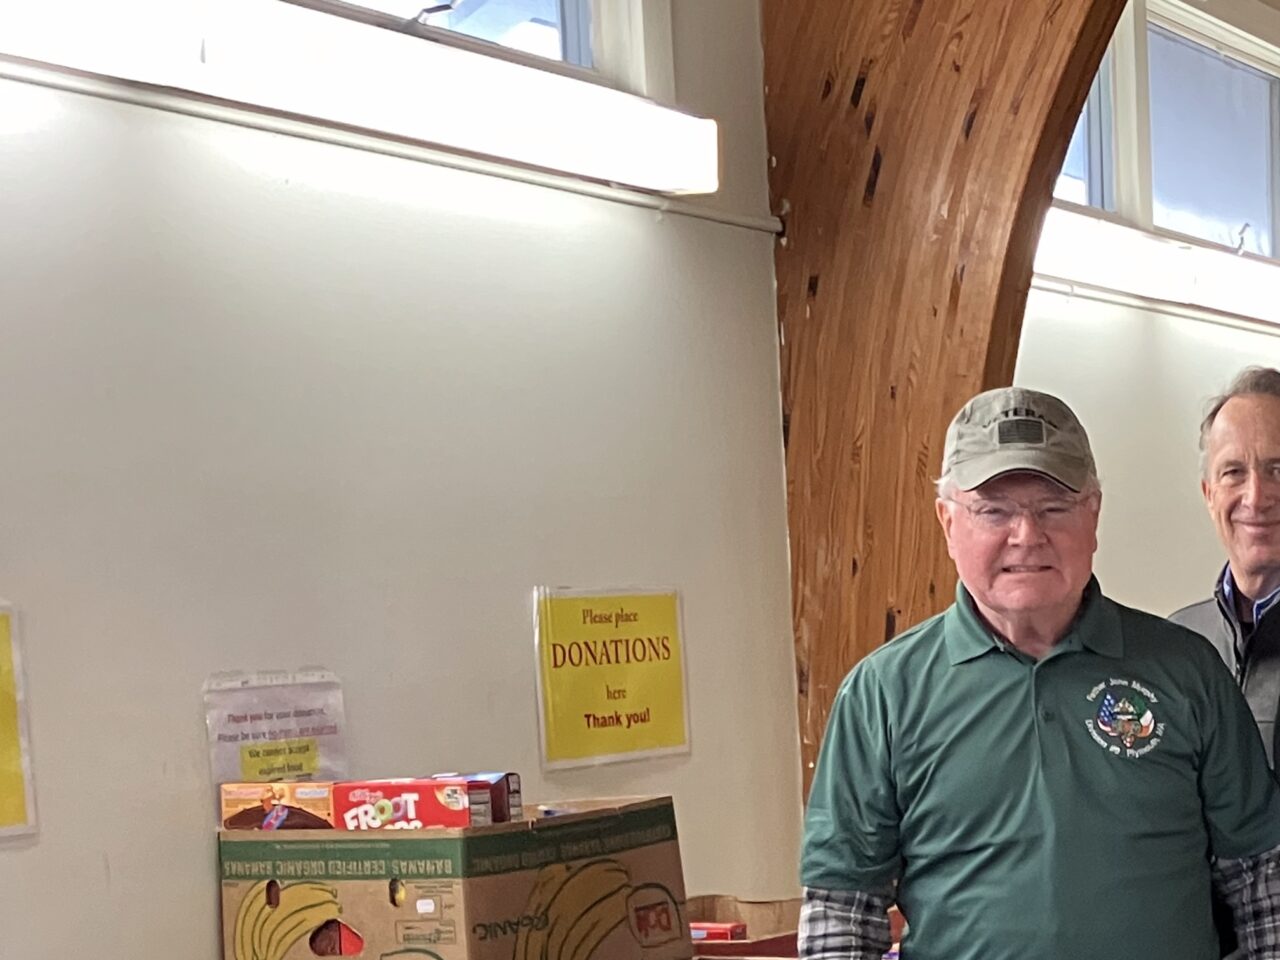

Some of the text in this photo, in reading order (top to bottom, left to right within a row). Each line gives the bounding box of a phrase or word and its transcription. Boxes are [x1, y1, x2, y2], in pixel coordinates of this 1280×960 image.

[582, 607, 638, 628] Please place
[551, 636, 671, 669] DONATIONS
[605, 684, 627, 701] here
[584, 707, 651, 729] Thank you!
[343, 792, 419, 830] FROOT
[276, 860, 325, 875] ORGANIC
[328, 859, 385, 875] CERTIFIED
